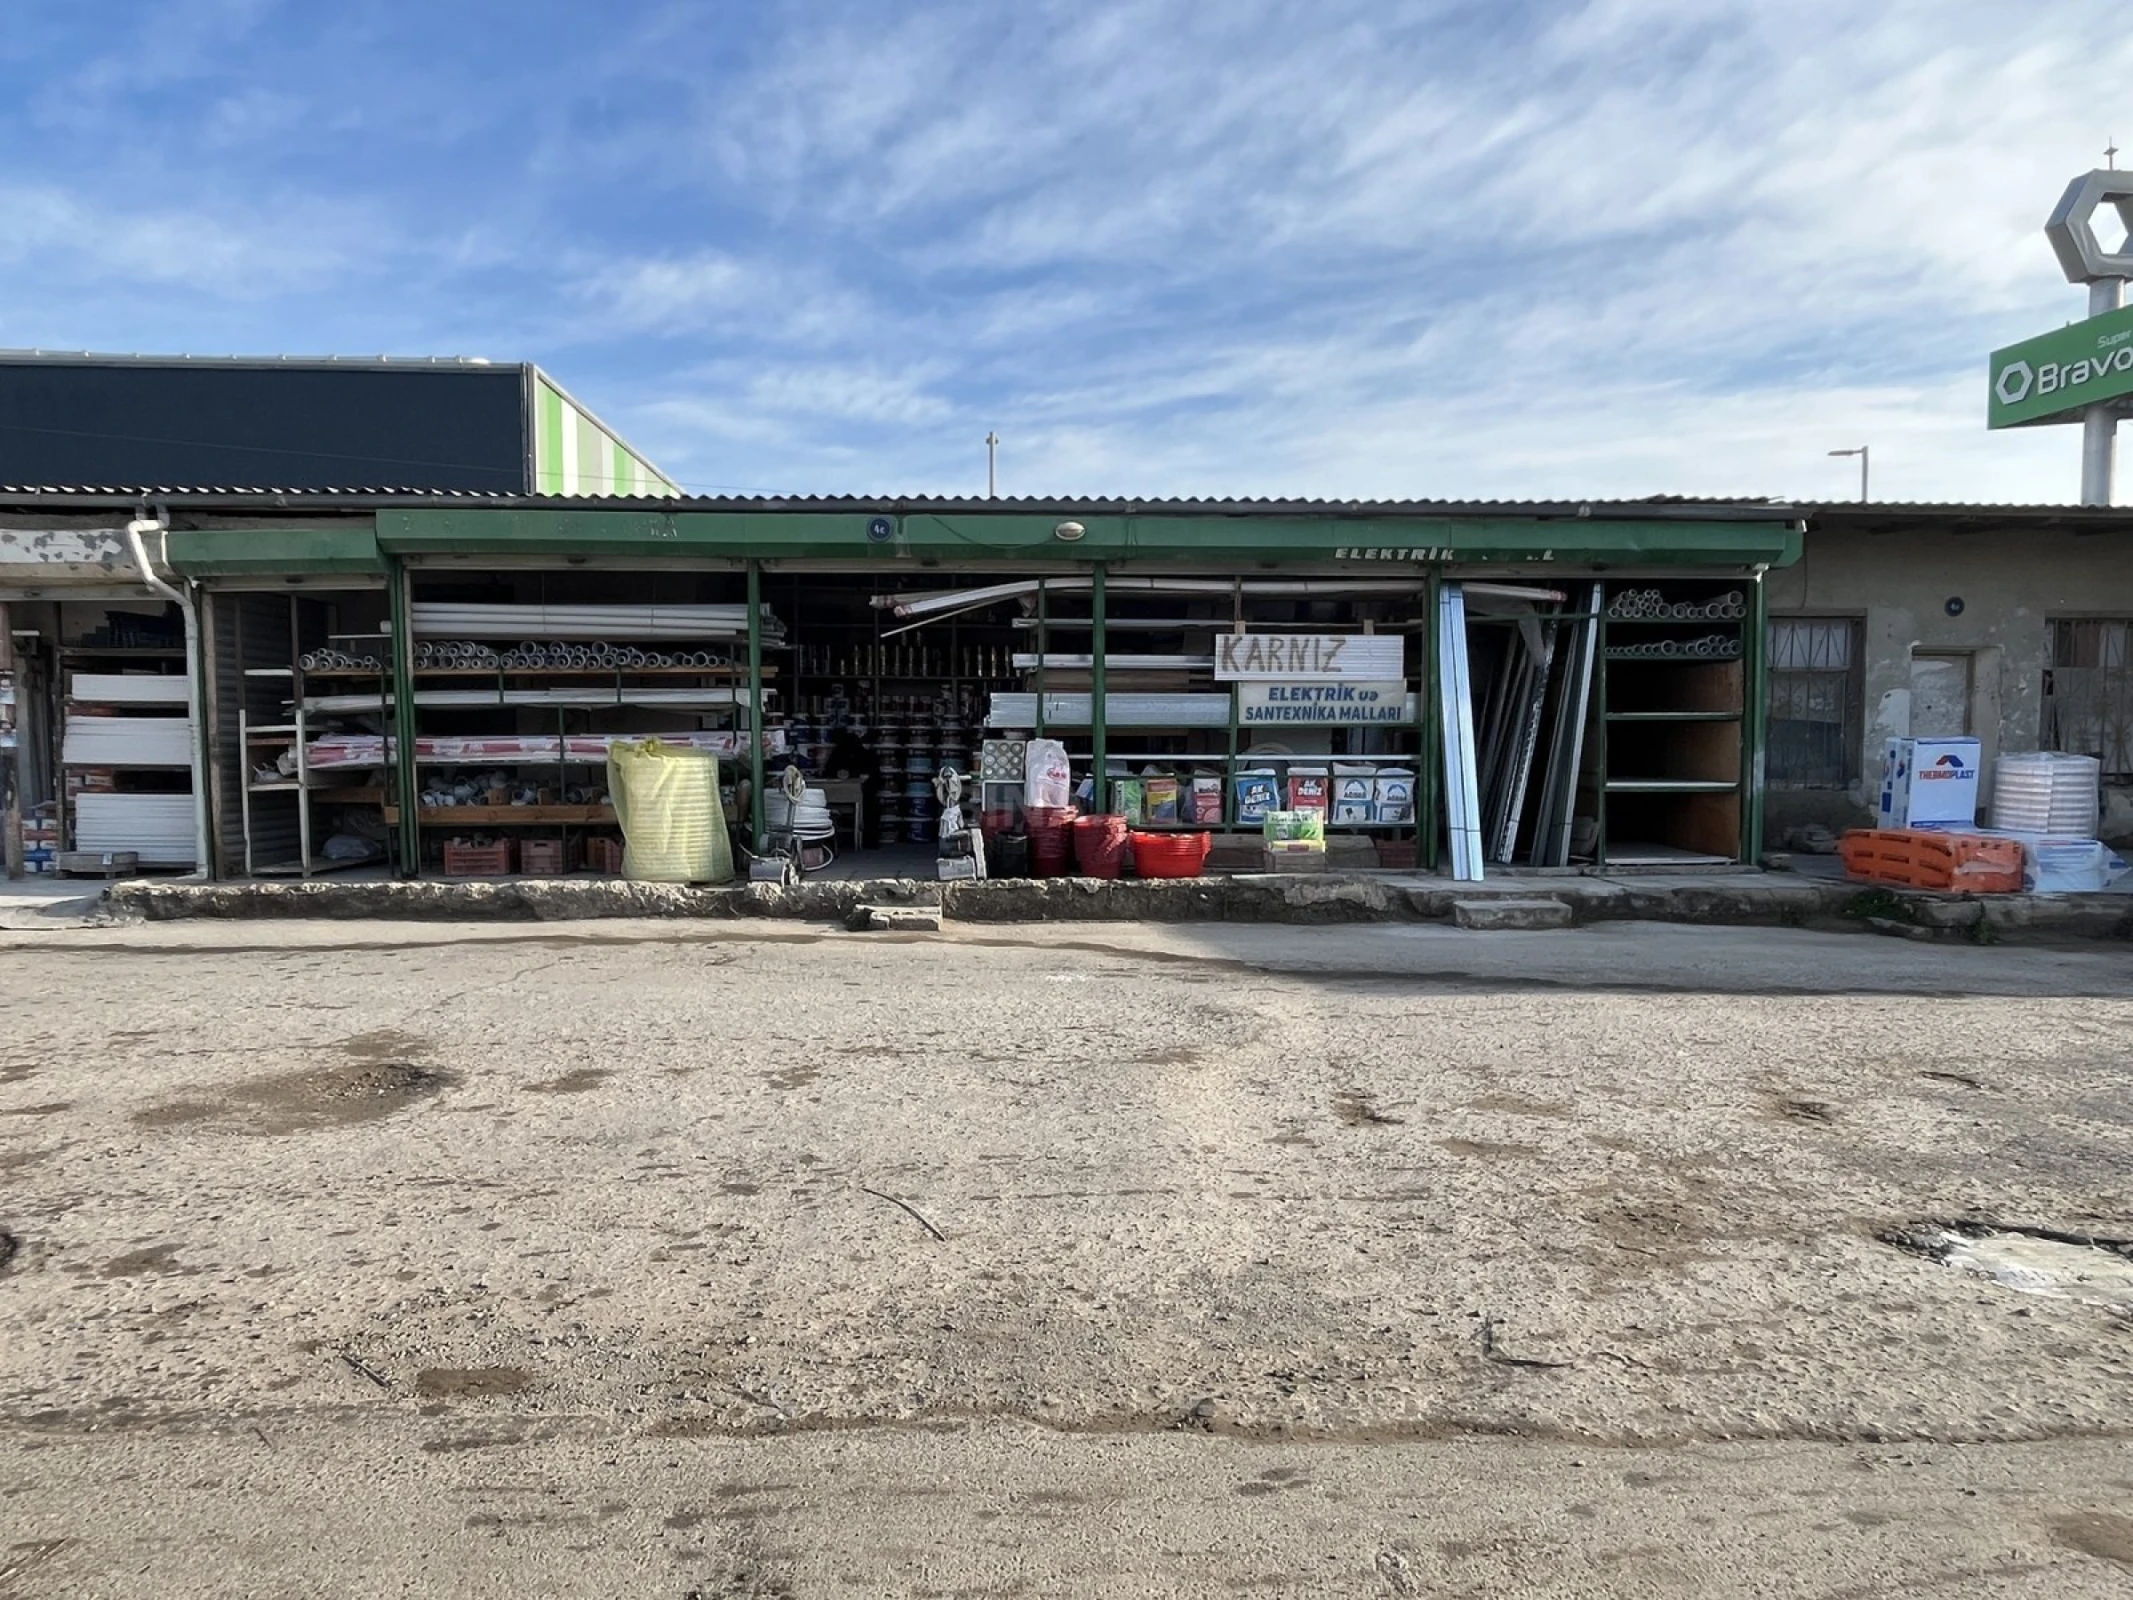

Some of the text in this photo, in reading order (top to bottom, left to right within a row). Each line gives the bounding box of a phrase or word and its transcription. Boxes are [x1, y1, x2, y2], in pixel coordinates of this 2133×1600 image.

[2038, 346, 2133, 395] Bravo
[1268, 683, 1355, 701] ELEKTRİK
[1245, 702, 1401, 721] SANTEXNİKA MALLARI
[1919, 770, 1975, 780] THERMOPLAST
